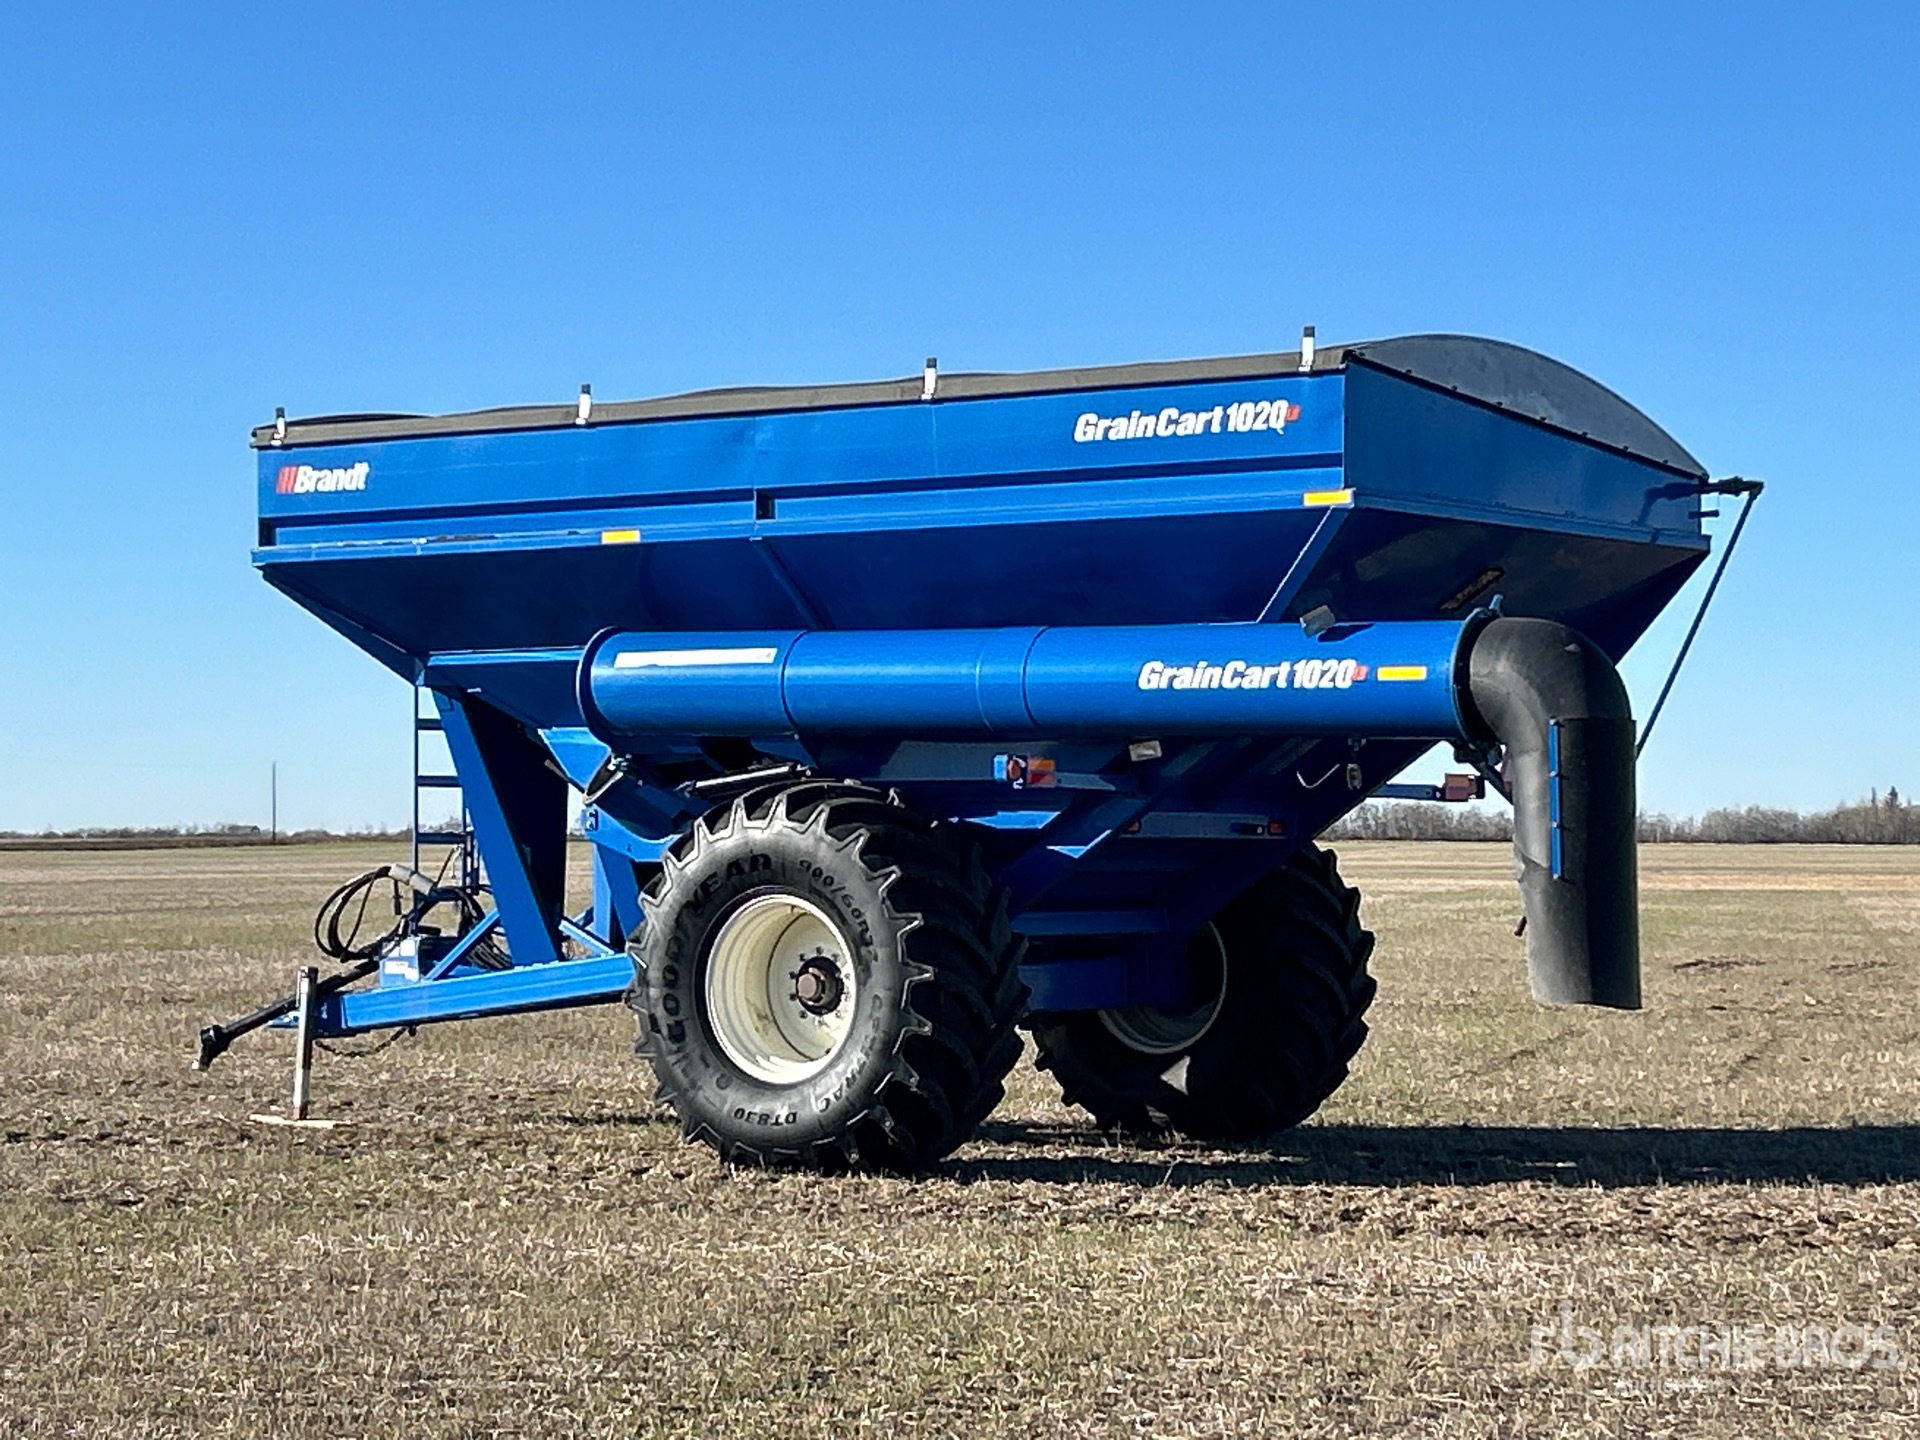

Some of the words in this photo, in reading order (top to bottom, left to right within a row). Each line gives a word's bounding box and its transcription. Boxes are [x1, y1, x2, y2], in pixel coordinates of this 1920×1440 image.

[1073, 405, 1225, 443] GrainCart
[1226, 400, 1289, 434] 1020
[294, 461, 370, 493] Brandt
[1138, 660, 1290, 690] GrainCart
[1293, 659, 1357, 688] 1020
[733, 1107, 798, 1127] DT830
